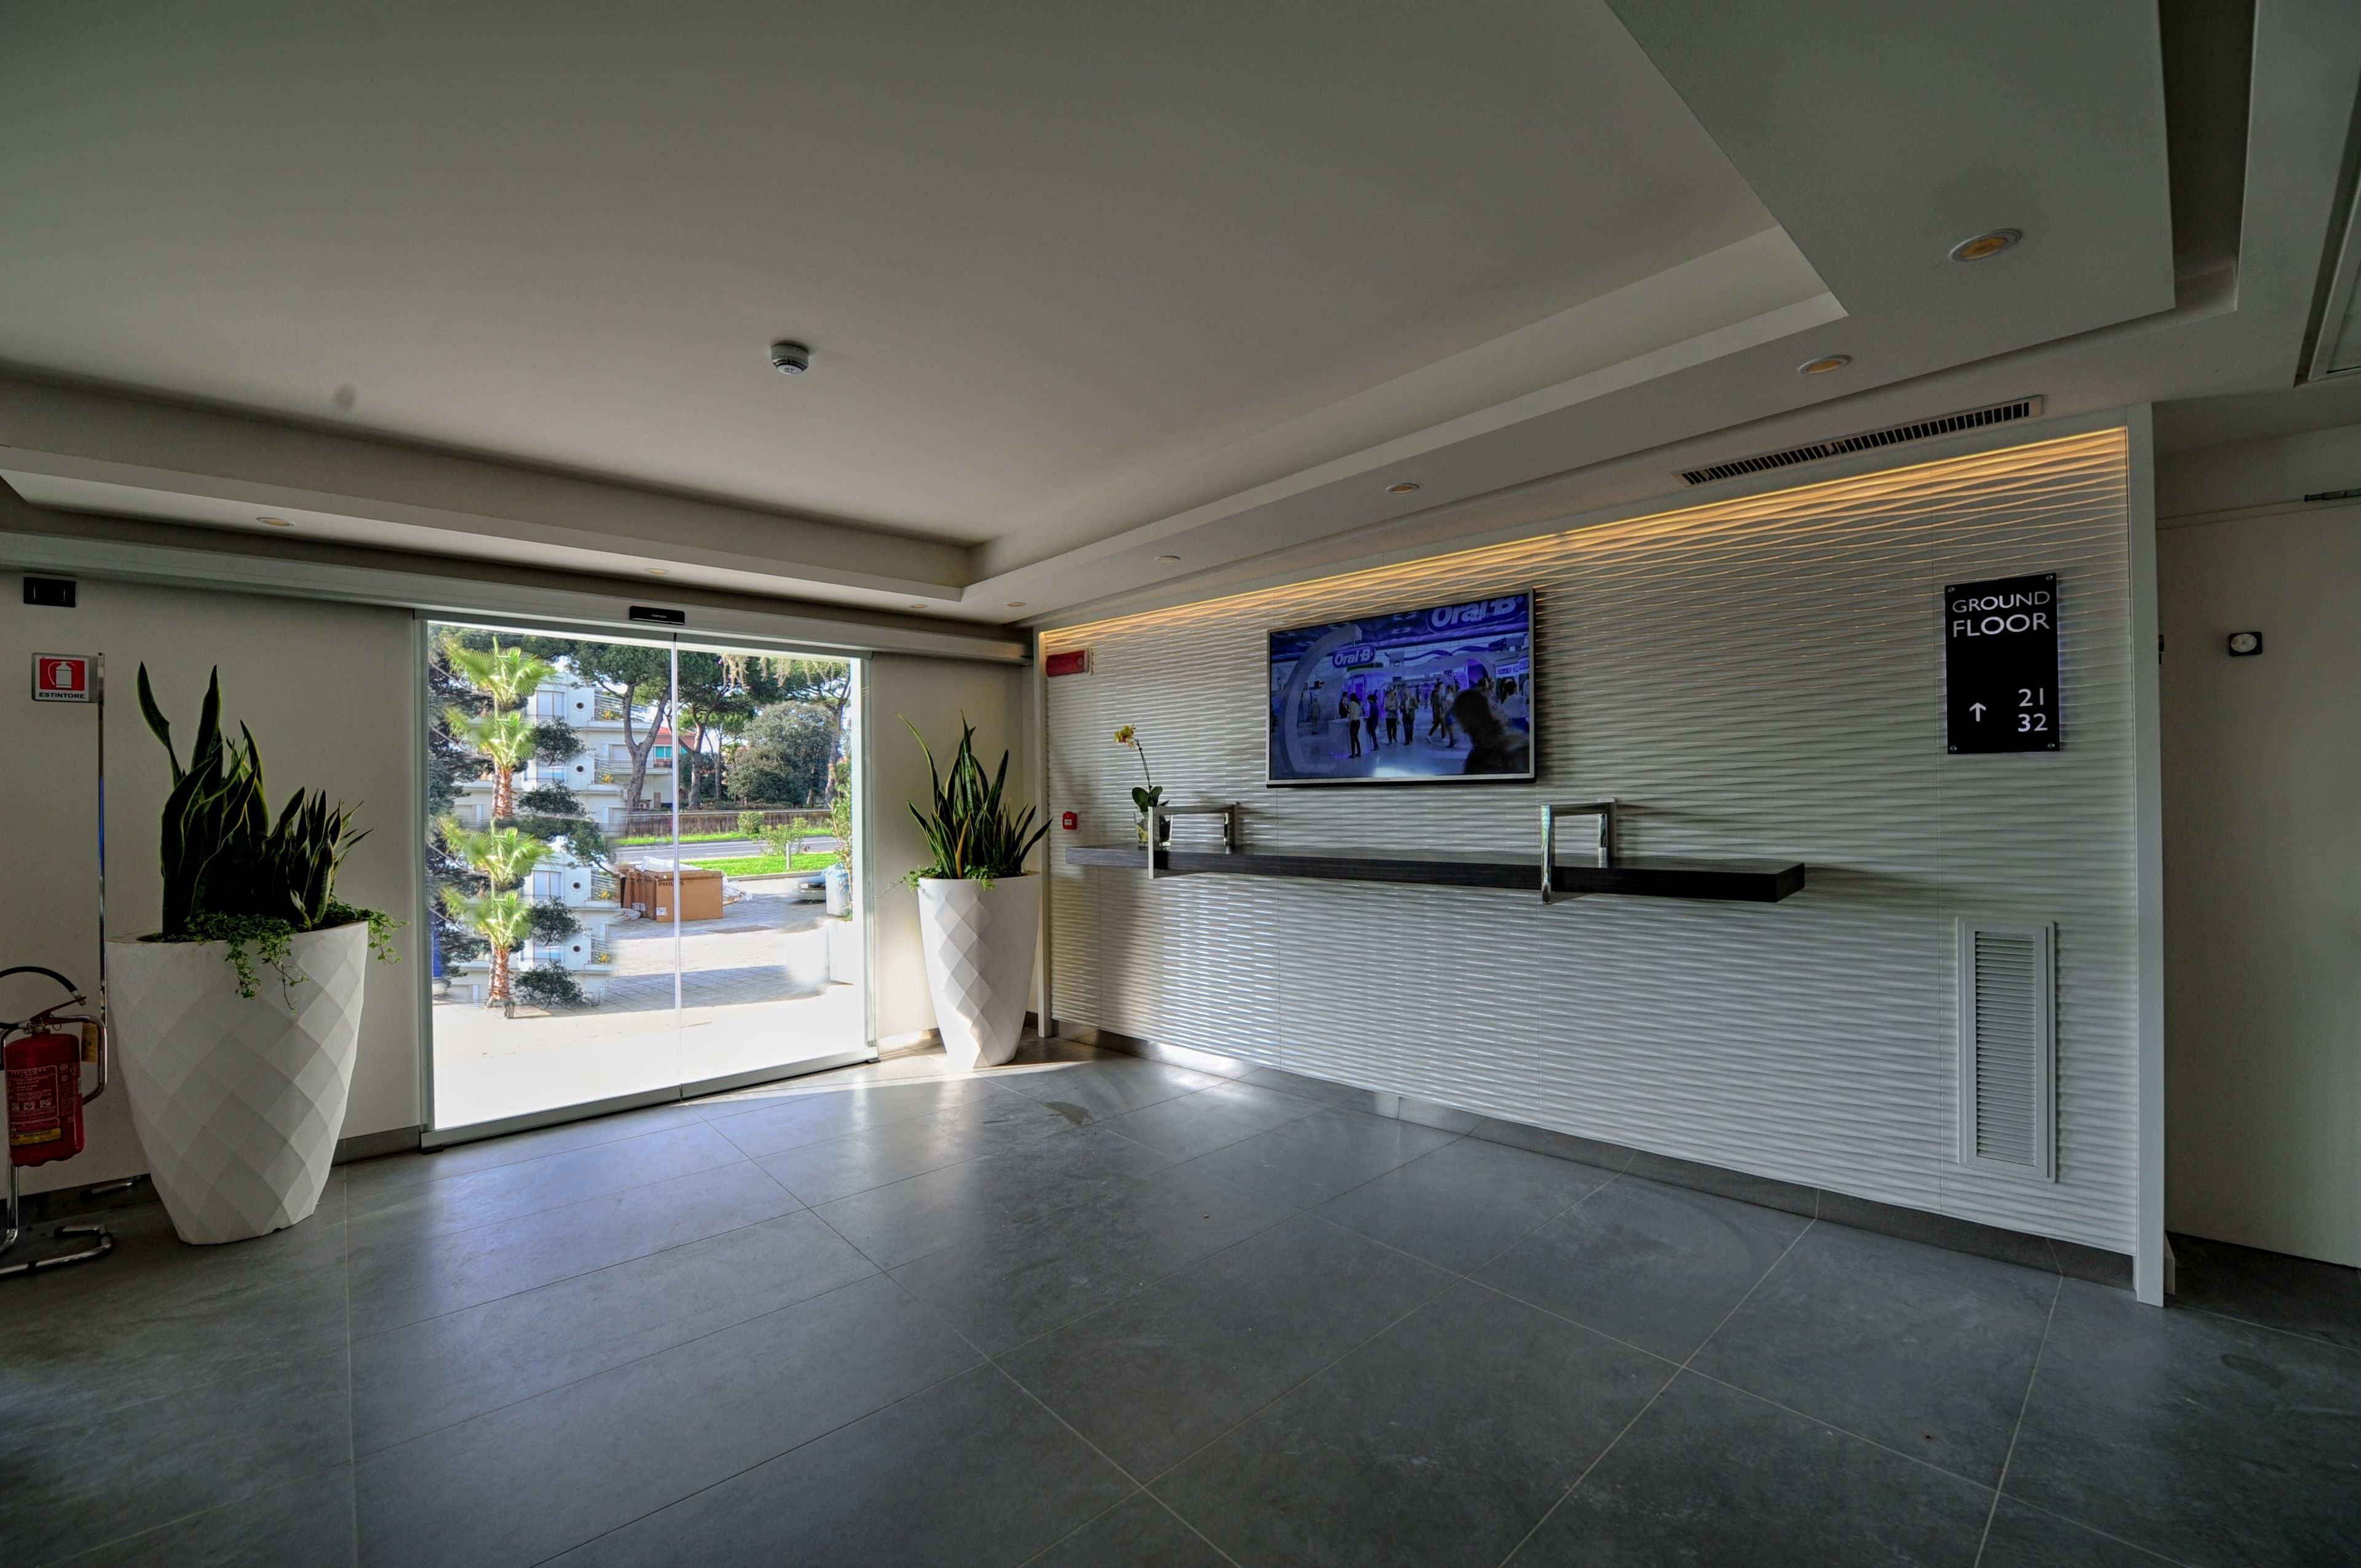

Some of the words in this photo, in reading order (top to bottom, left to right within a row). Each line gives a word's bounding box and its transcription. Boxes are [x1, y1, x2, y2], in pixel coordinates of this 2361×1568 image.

[1952, 591, 2051, 612] GROUND
[1953, 612, 2051, 638] FLOOR
[2018, 687, 2044, 707] 21
[2018, 713, 2048, 732] 32
